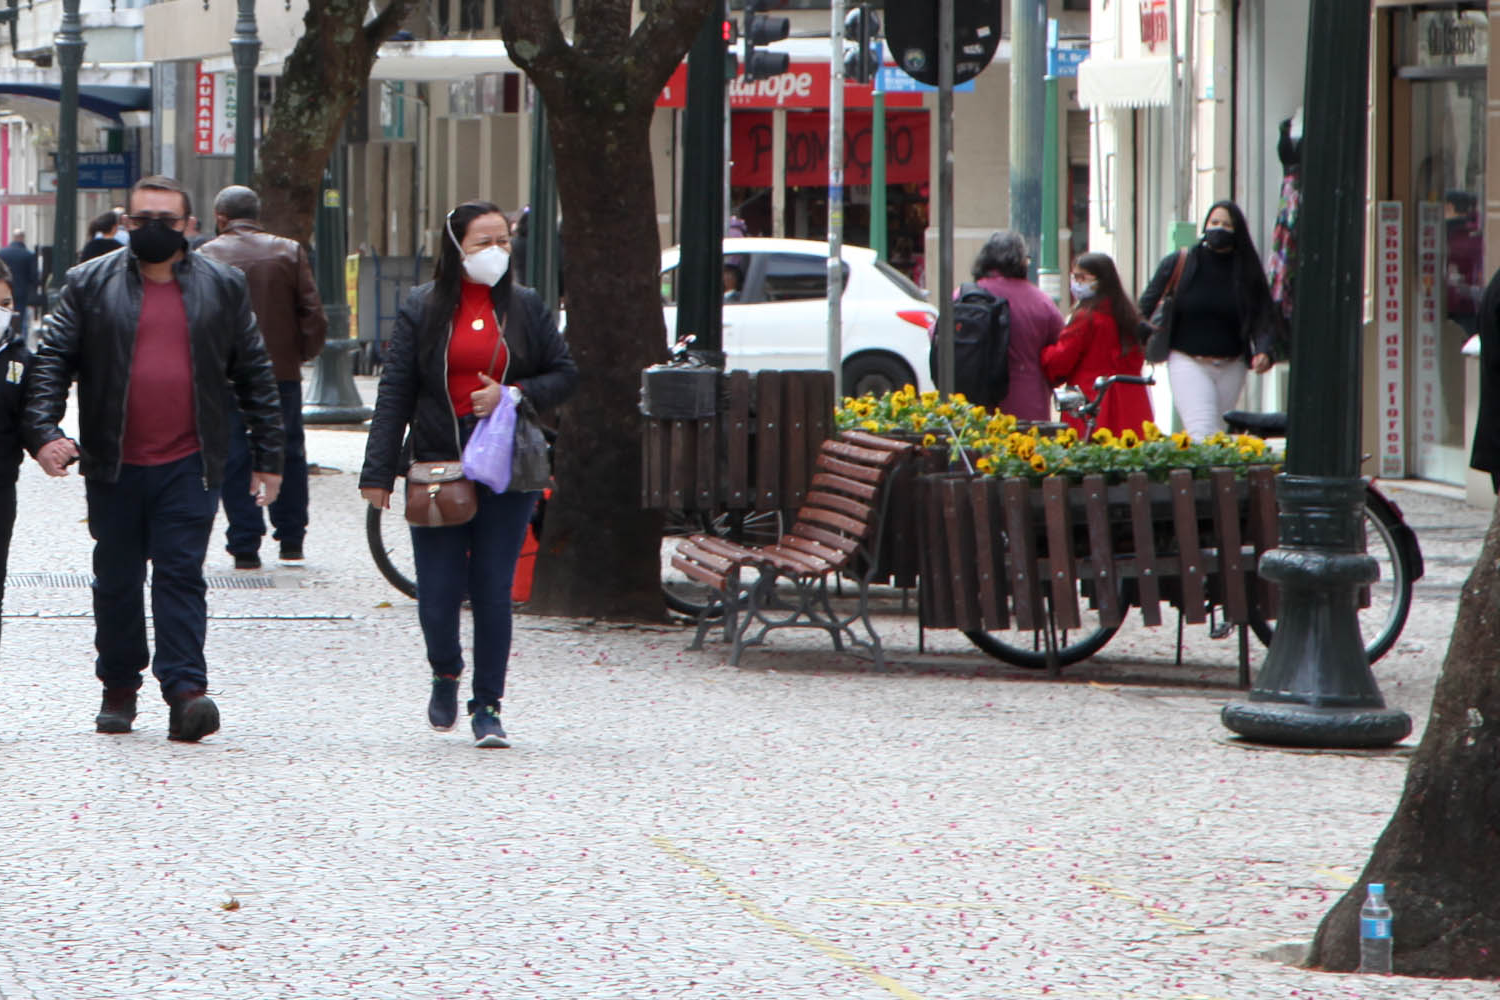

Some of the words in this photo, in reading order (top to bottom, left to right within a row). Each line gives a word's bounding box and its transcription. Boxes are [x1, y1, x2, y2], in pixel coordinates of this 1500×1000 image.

[199, 74, 212, 152] AURANTE
[78, 153, 125, 165] NTISTA
[1385, 224, 1399, 322] Shopping
[1385, 333, 1399, 370] das
[1386, 382, 1399, 454] Flores
